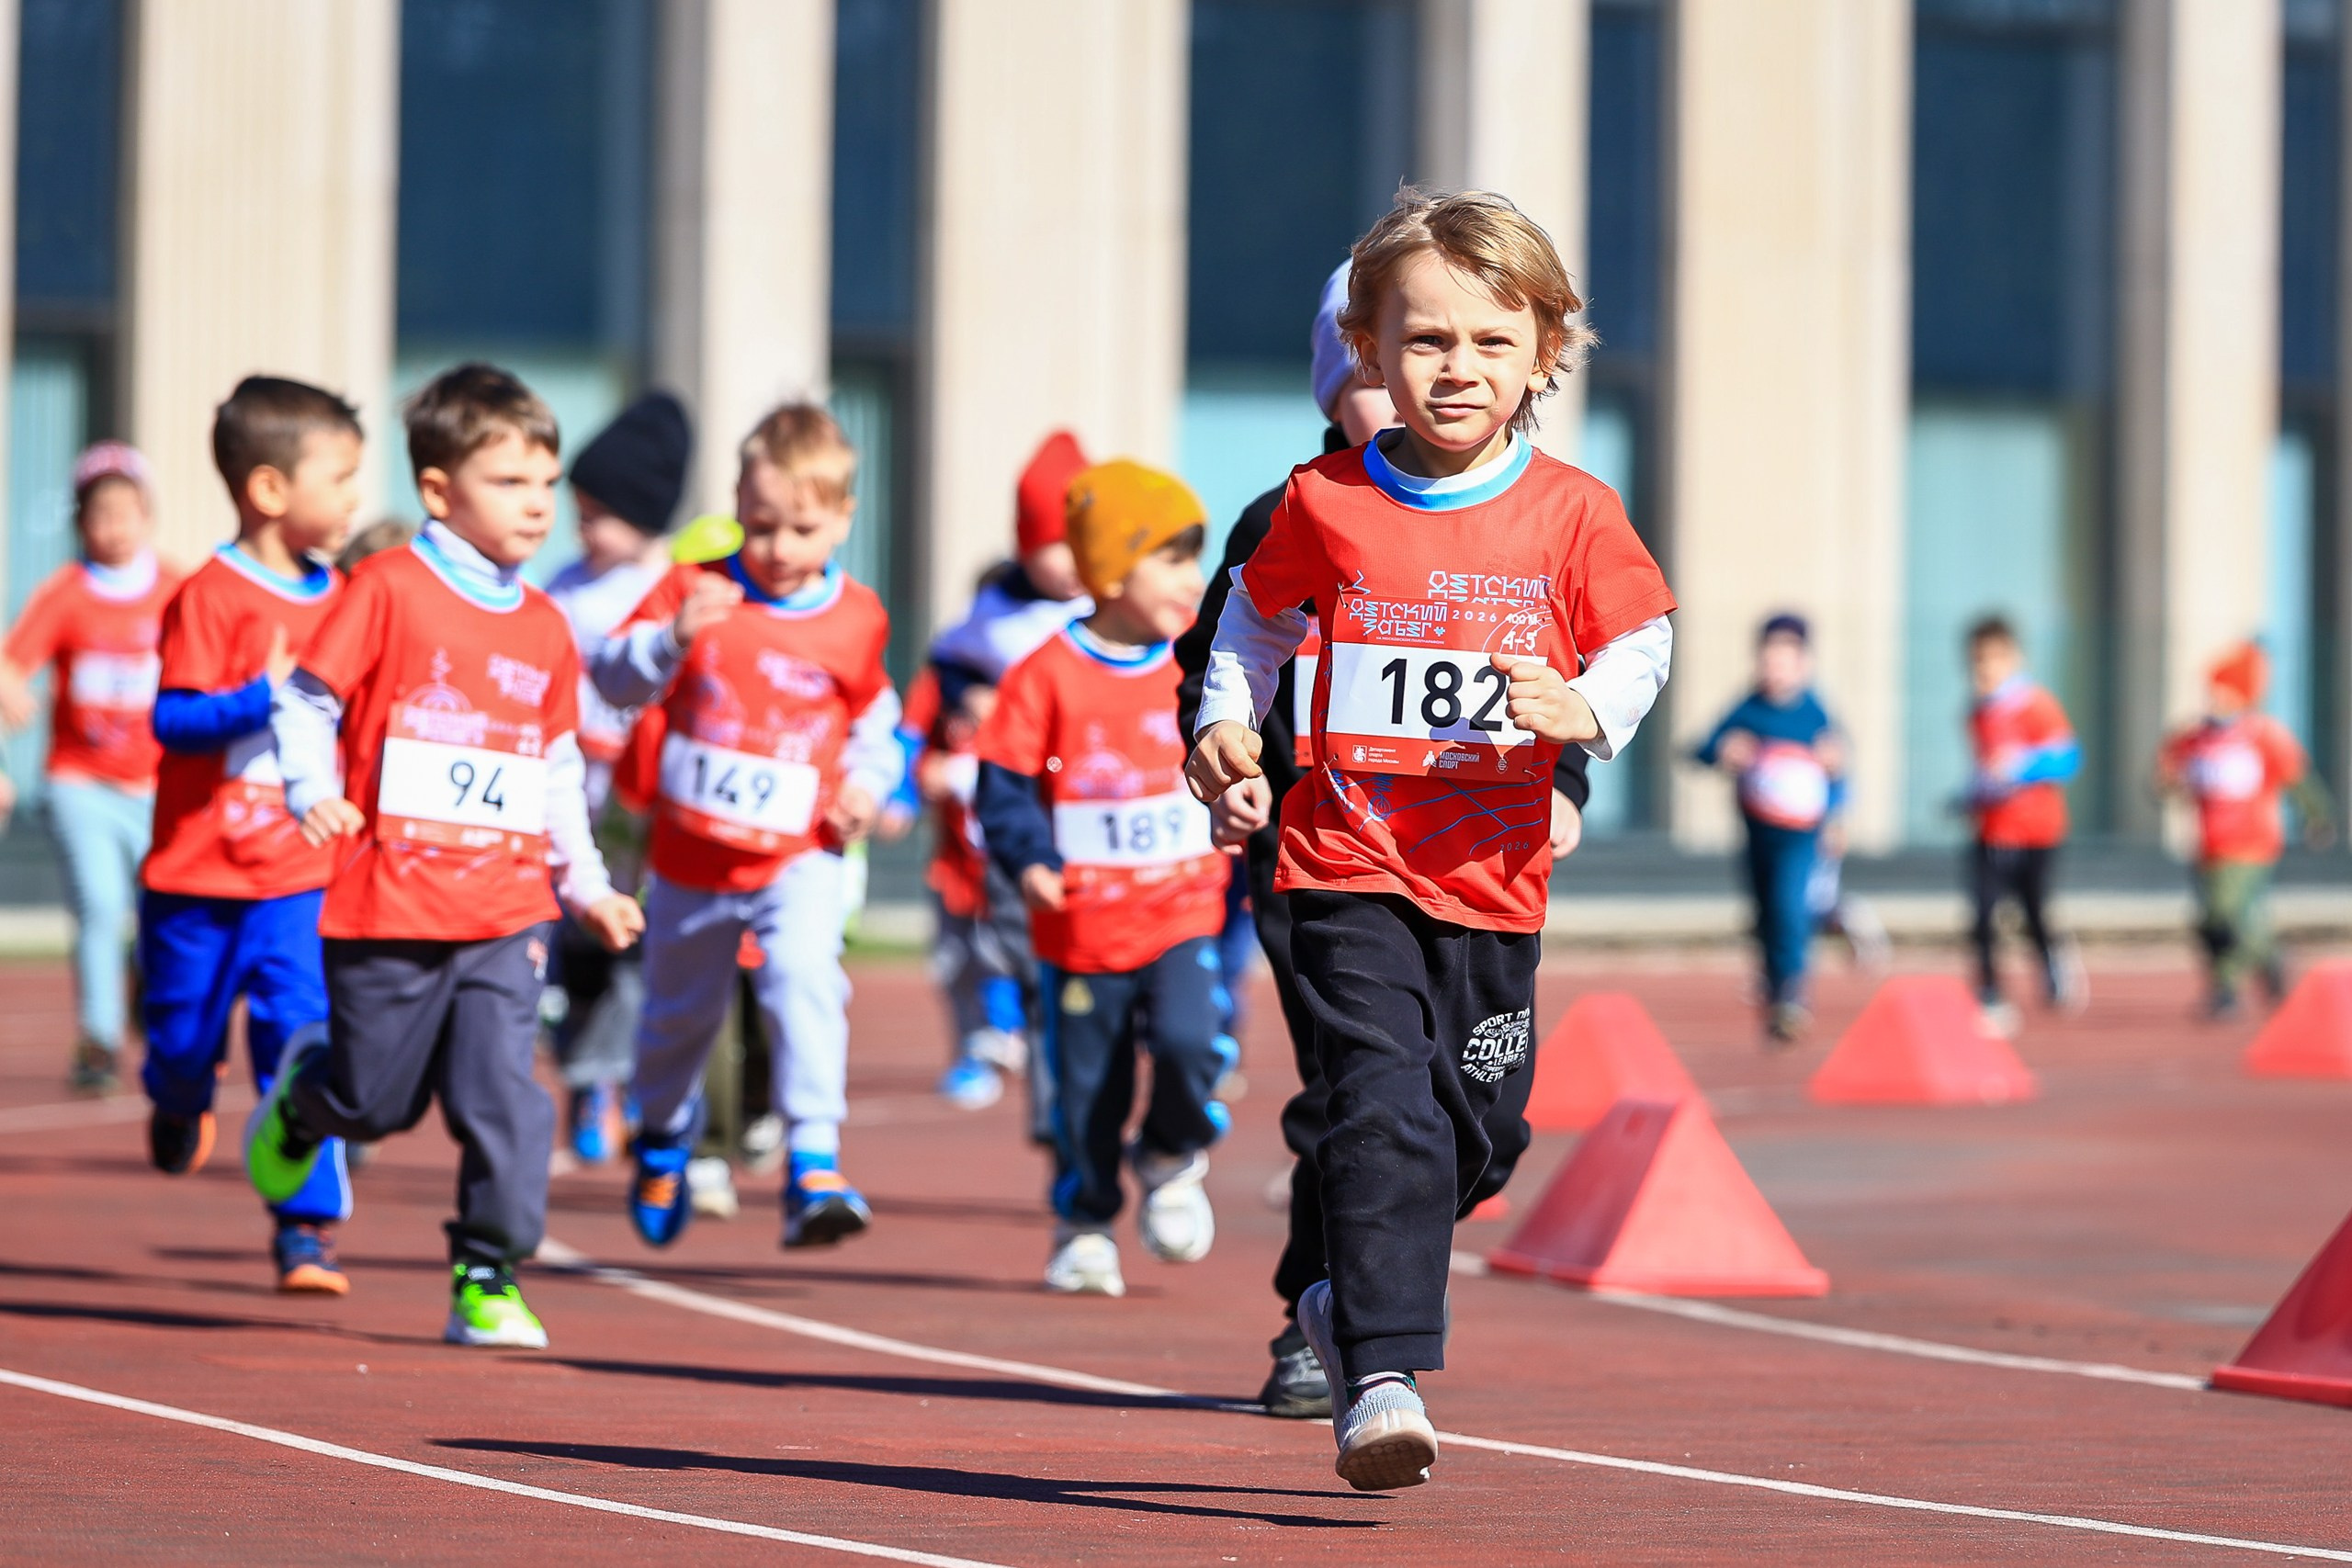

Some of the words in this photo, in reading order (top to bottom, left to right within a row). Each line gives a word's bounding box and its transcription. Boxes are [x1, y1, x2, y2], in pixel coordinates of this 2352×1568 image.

[1349, 598, 1448, 622] ДЕТСКИЙ
[1453, 609, 1498, 623] 2026
[1504, 613, 1527, 625] 400
[1363, 618, 1432, 637] ЗАБЕГ
[1501, 630, 1538, 651] 4-5
[1381, 658, 1508, 732] 182
[1439, 750, 1480, 762] МОСКОВСКИЙ
[1439, 760, 1459, 770] СПОРТ
[449, 761, 504, 812] 94
[695, 755, 774, 810] 149
[1100, 807, 1185, 852] 189
[1499, 840, 1530, 853] 2026
[1472, 1012, 1513, 1036] SPORT
[1462, 1032, 1529, 1062] COLLE
